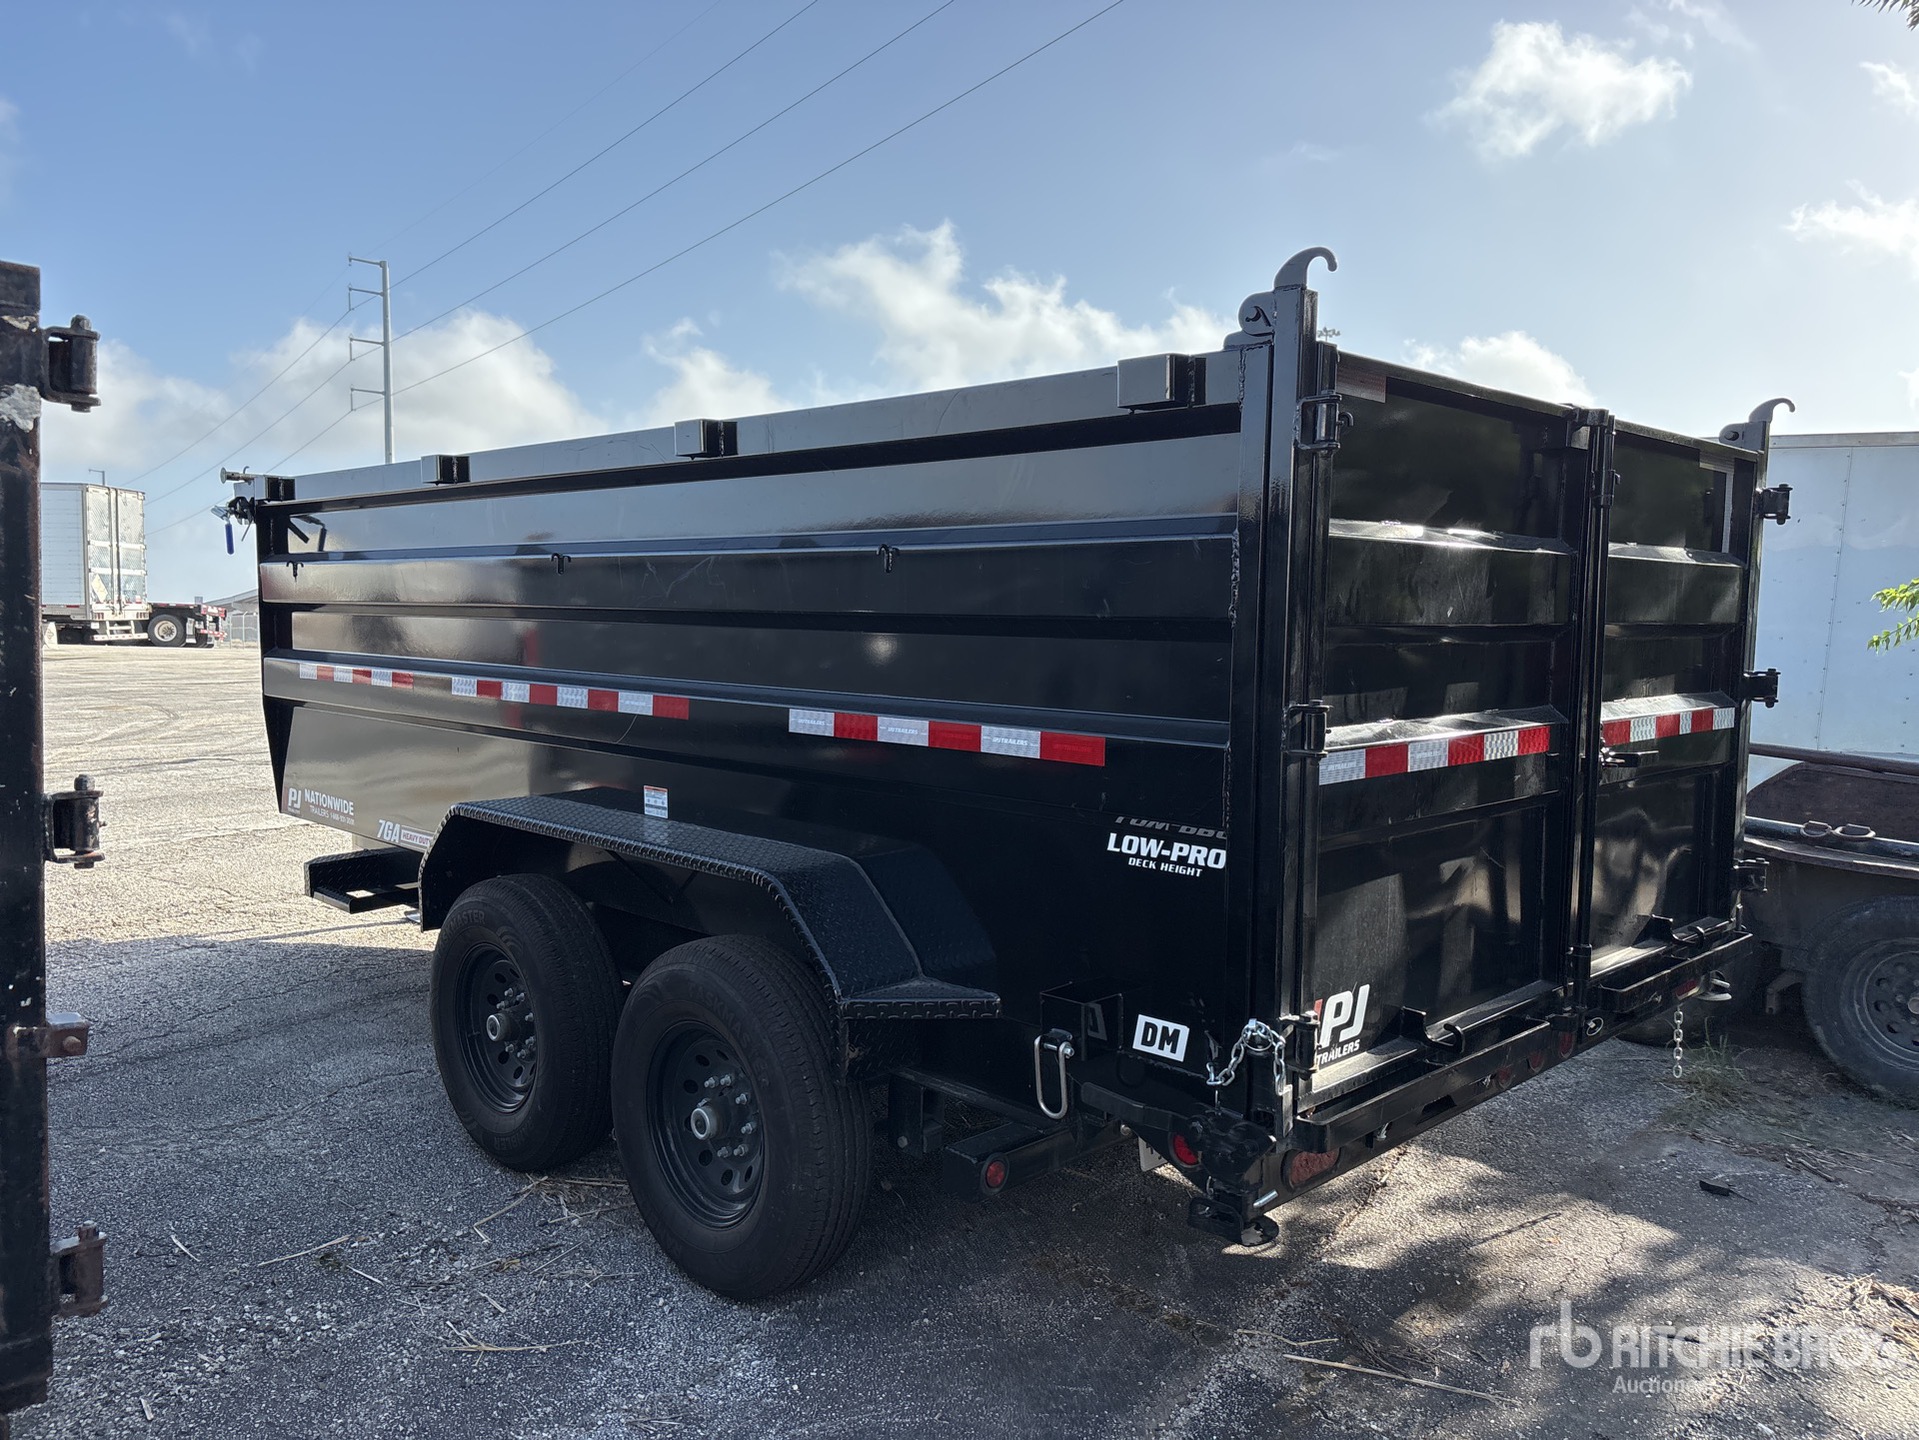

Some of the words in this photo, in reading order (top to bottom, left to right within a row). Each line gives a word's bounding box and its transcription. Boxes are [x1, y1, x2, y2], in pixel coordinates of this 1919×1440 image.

[287, 787, 302, 809] PJ
[304, 788, 355, 816] NATIONWIDE
[309, 804, 331, 818] TRAILERS
[377, 819, 401, 843] 7GA
[402, 831, 419, 843] HEAVY
[1106, 832, 1227, 870] LOW-PRO
[1128, 857, 1157, 870] DECK
[1160, 862, 1203, 878] HEIGHT
[1318, 983, 1370, 1050] PJ
[1140, 1020, 1181, 1055] DM
[1316, 1038, 1361, 1066] TRAILERS
